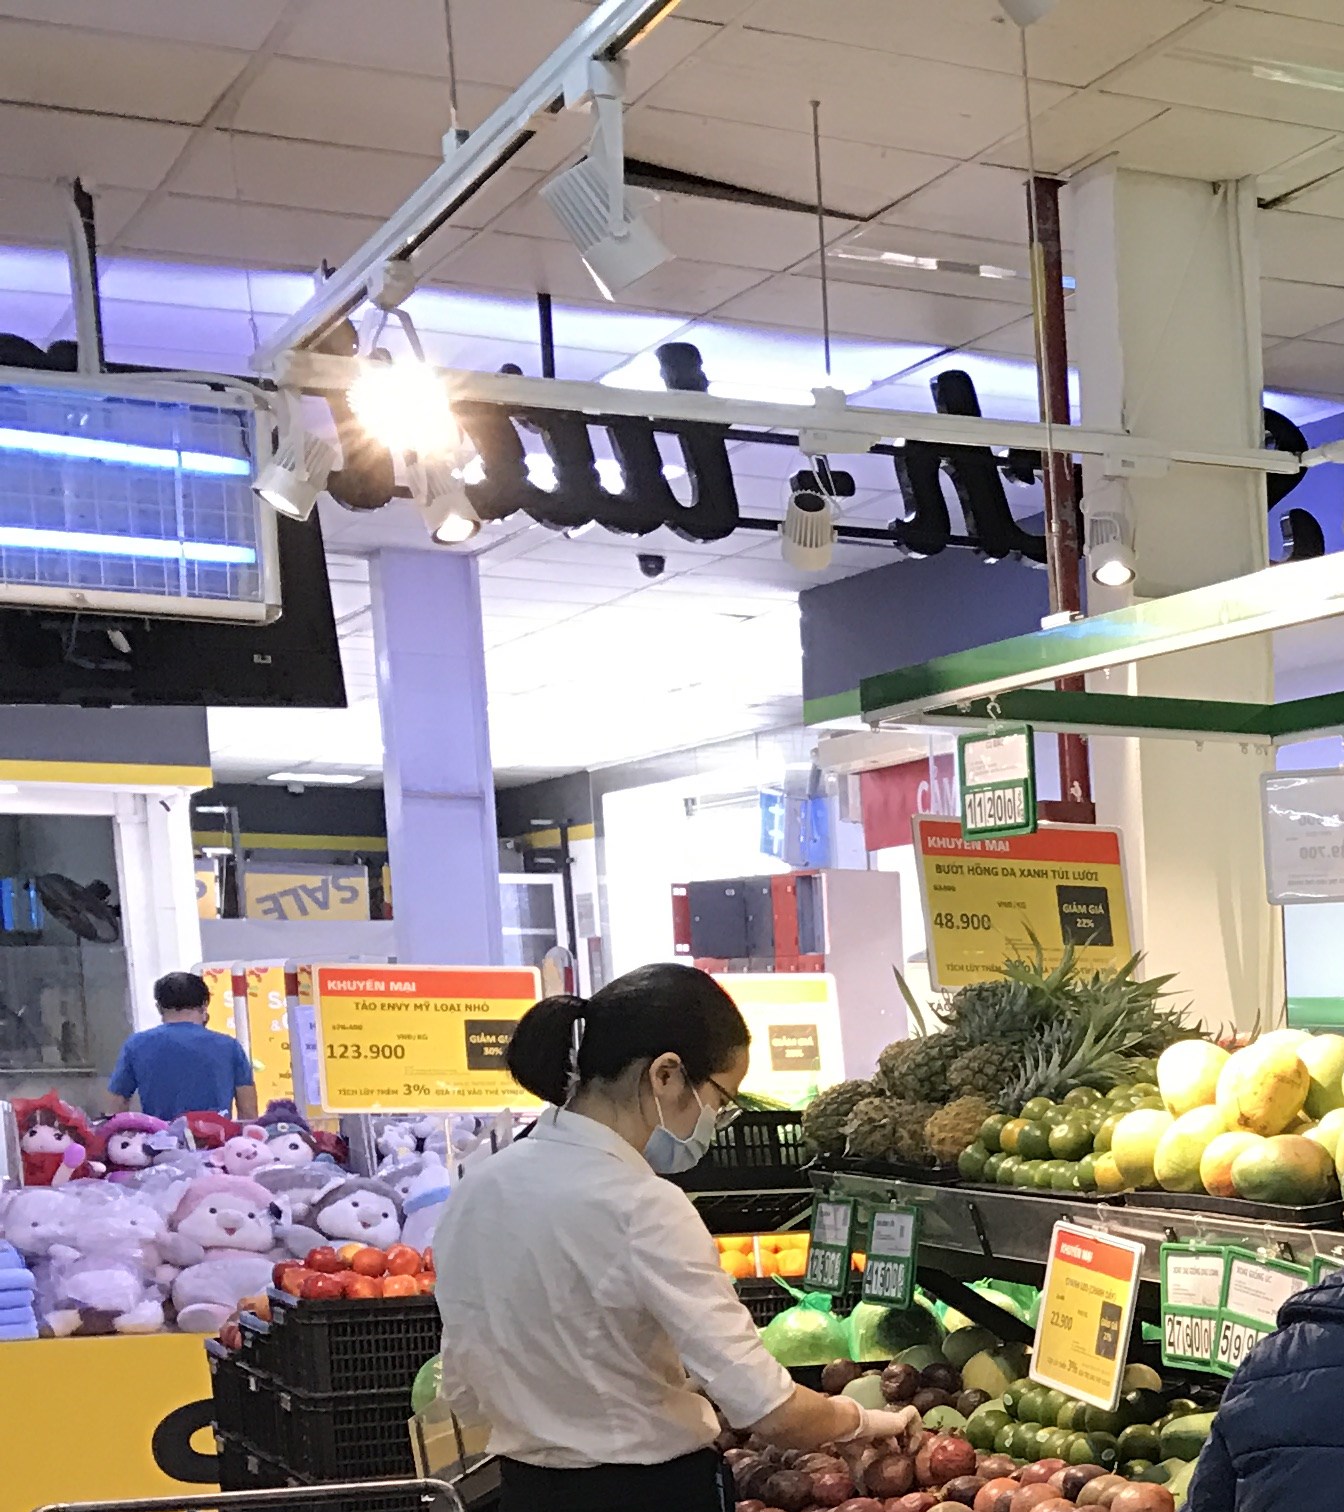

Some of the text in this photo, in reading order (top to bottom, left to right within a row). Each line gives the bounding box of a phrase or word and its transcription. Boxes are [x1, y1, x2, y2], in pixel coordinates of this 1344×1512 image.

[1019, 868, 1049, 879] XANH
[255, 872, 359, 920] SALE
[933, 912, 992, 931] 48.900
[327, 978, 417, 994] KHUYẾN MẠI
[380, 1002, 410, 1012] ENVY
[326, 1043, 405, 1060] 123.900
[403, 1083, 430, 1096] 3%
